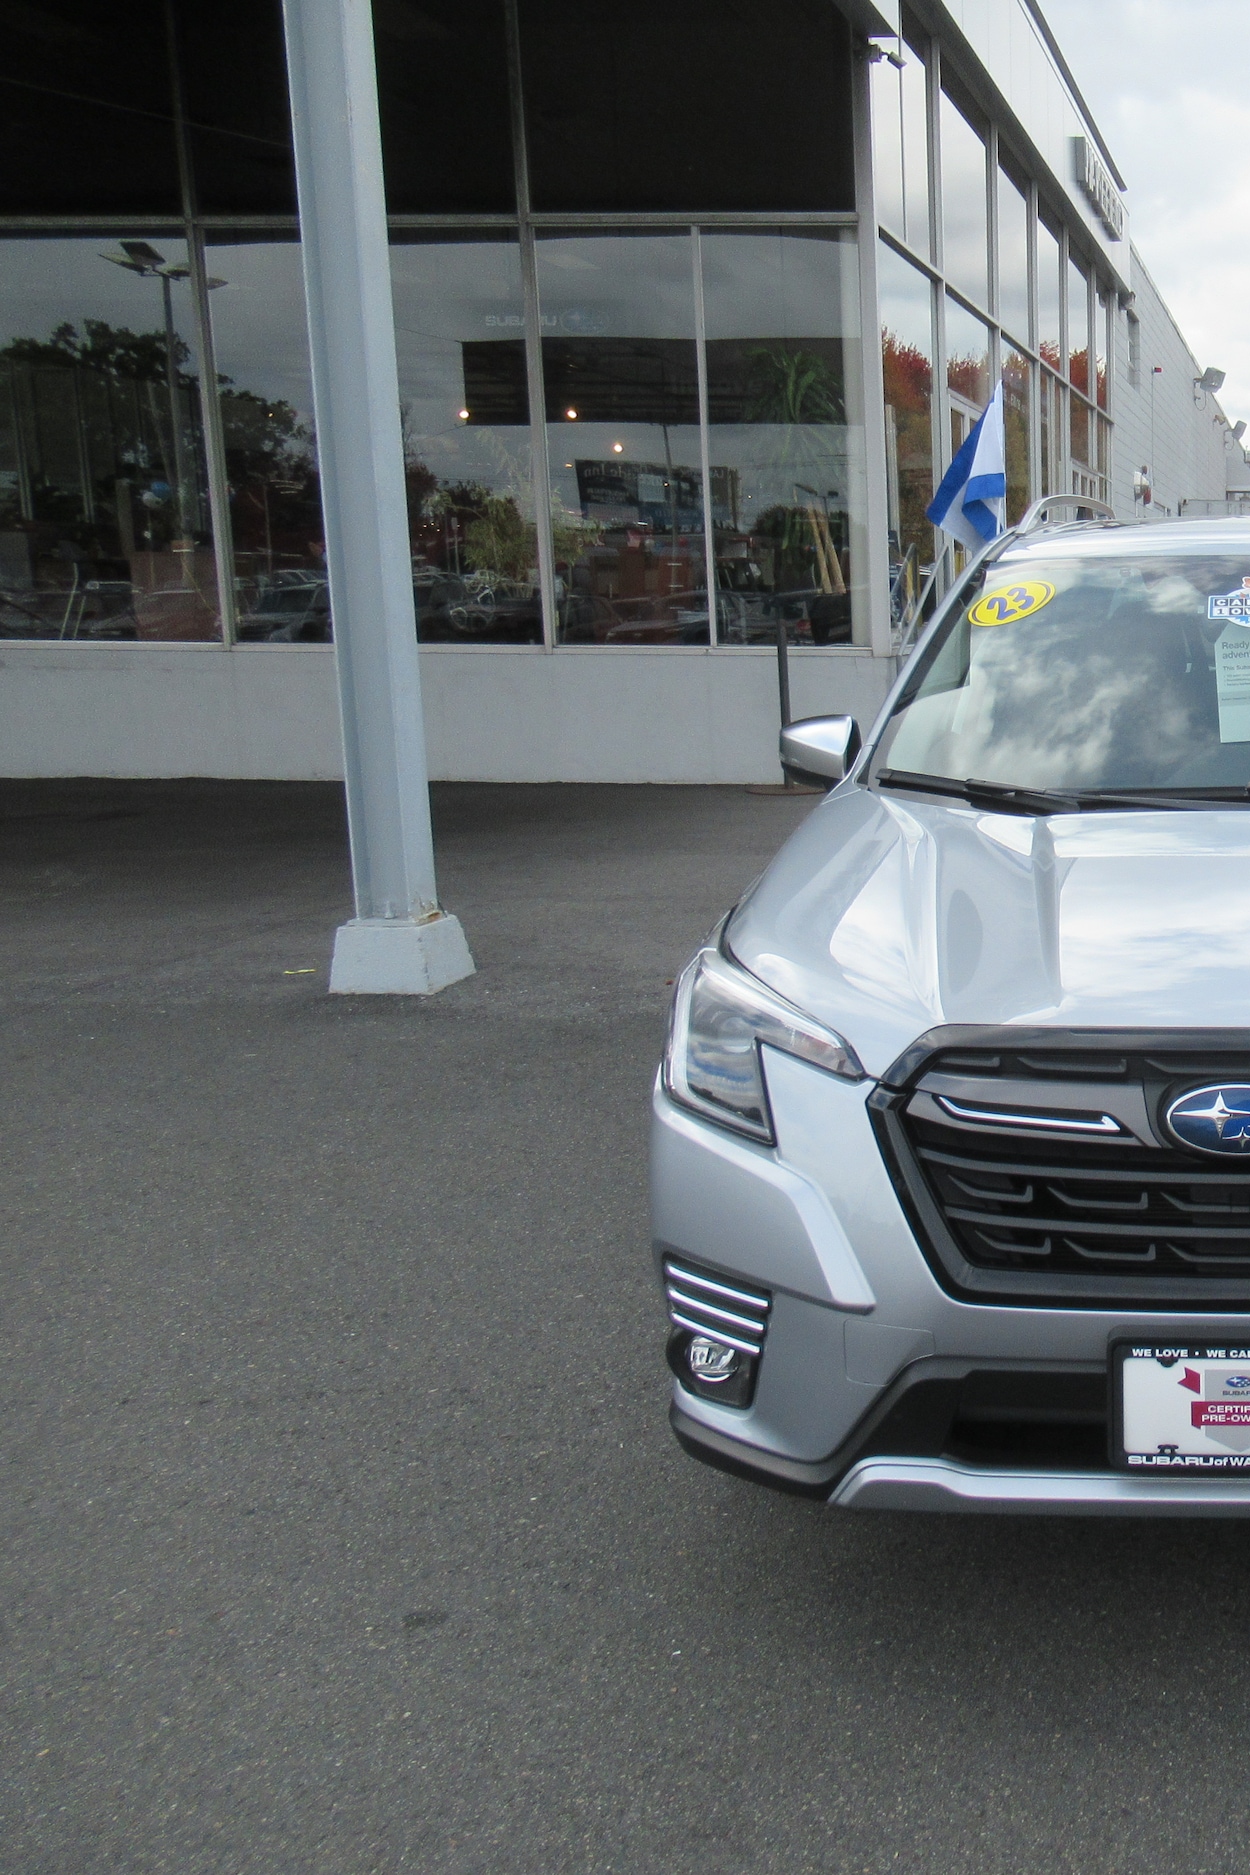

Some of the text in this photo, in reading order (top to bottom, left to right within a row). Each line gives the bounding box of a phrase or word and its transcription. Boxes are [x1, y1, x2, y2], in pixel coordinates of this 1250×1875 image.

[987, 587, 1035, 621] 23
[1222, 641, 1250, 650] Ready
[1132, 1349, 1152, 1357] WE
[1155, 1349, 1188, 1357] LOVE
[1206, 1350, 1226, 1358] WE
